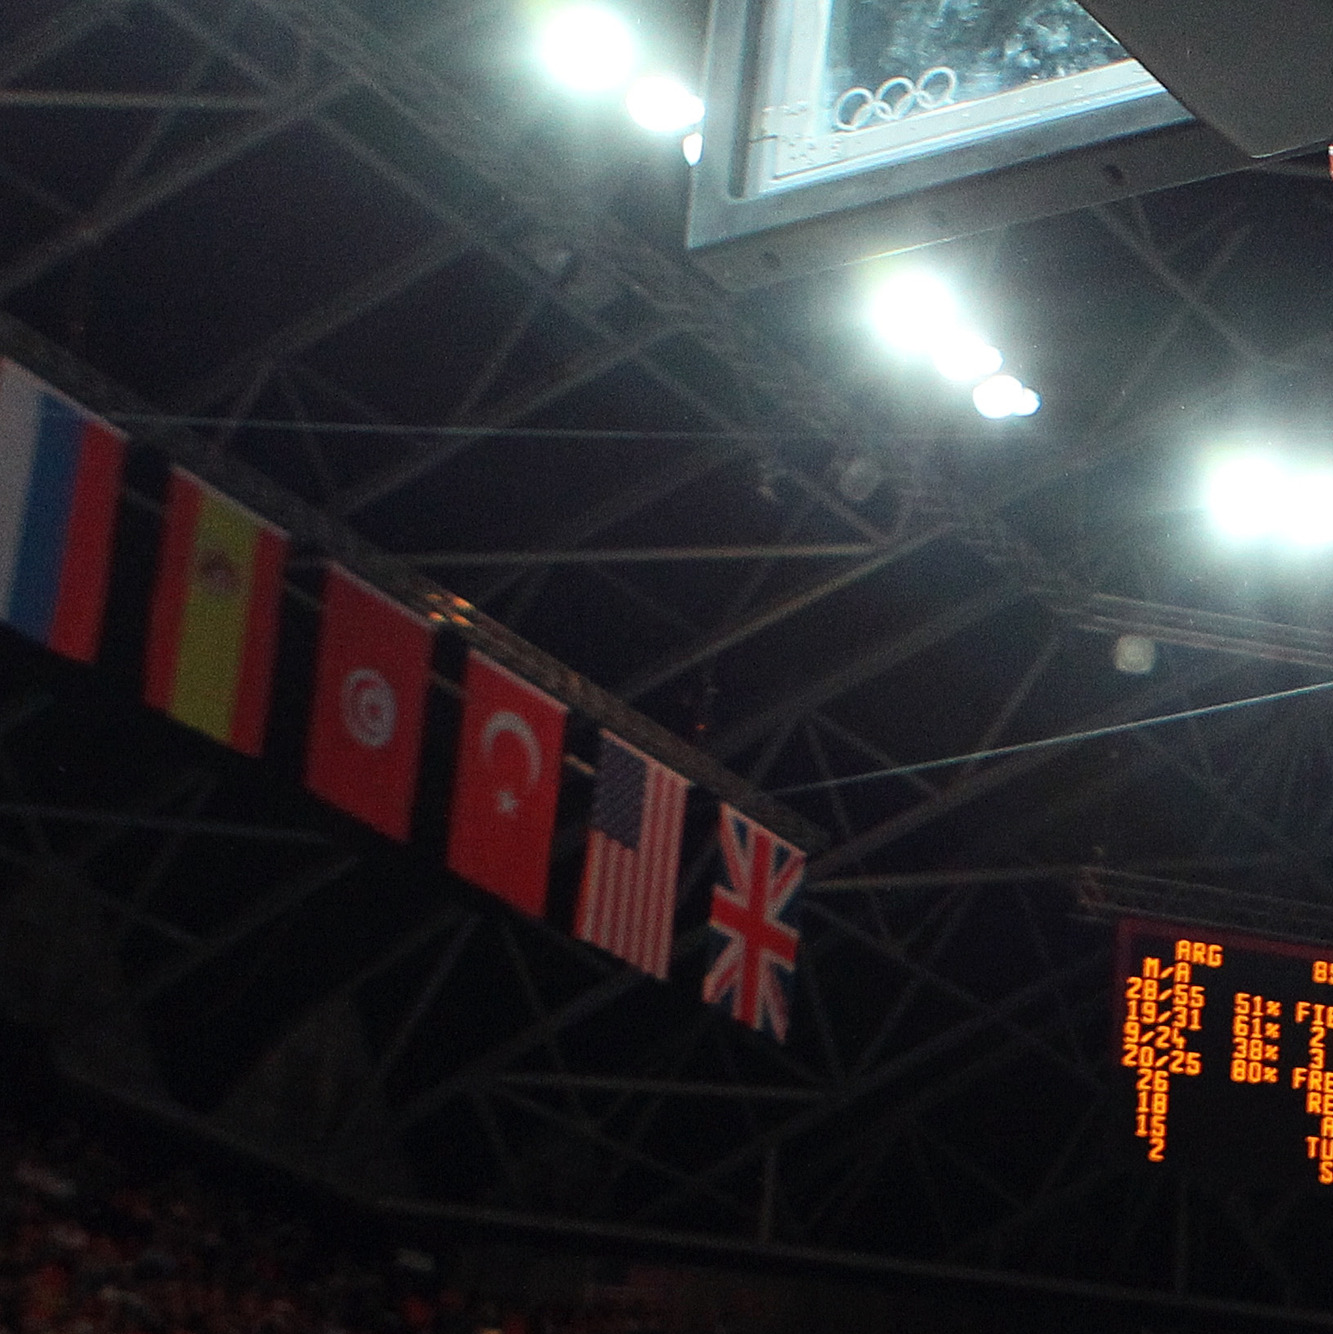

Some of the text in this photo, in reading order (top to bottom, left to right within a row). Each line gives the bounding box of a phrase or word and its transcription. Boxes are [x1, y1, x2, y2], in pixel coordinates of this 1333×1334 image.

[1175, 939, 1222, 967] ARG
[1142, 956, 1192, 985] M/A
[1125, 976, 1205, 1008] 28/55
[1234, 992, 1281, 1017] 51%
[1125, 1000, 1202, 1031] 19/31
[1233, 1014, 1280, 1039] 61%
[1309, 1025, 1326, 1048] 2
[1122, 1021, 1187, 1050] 9/24
[1232, 1037, 1279, 1061] 38%
[1307, 1047, 1325, 1070] 3
[1120, 1043, 1202, 1076] 20/25
[1230, 1058, 1278, 1083] 80%
[1136, 1067, 1169, 1093] 26
[1135, 1090, 1169, 1116] 18
[1134, 1114, 1167, 1138] 15
[1147, 1137, 1165, 1161] 2
